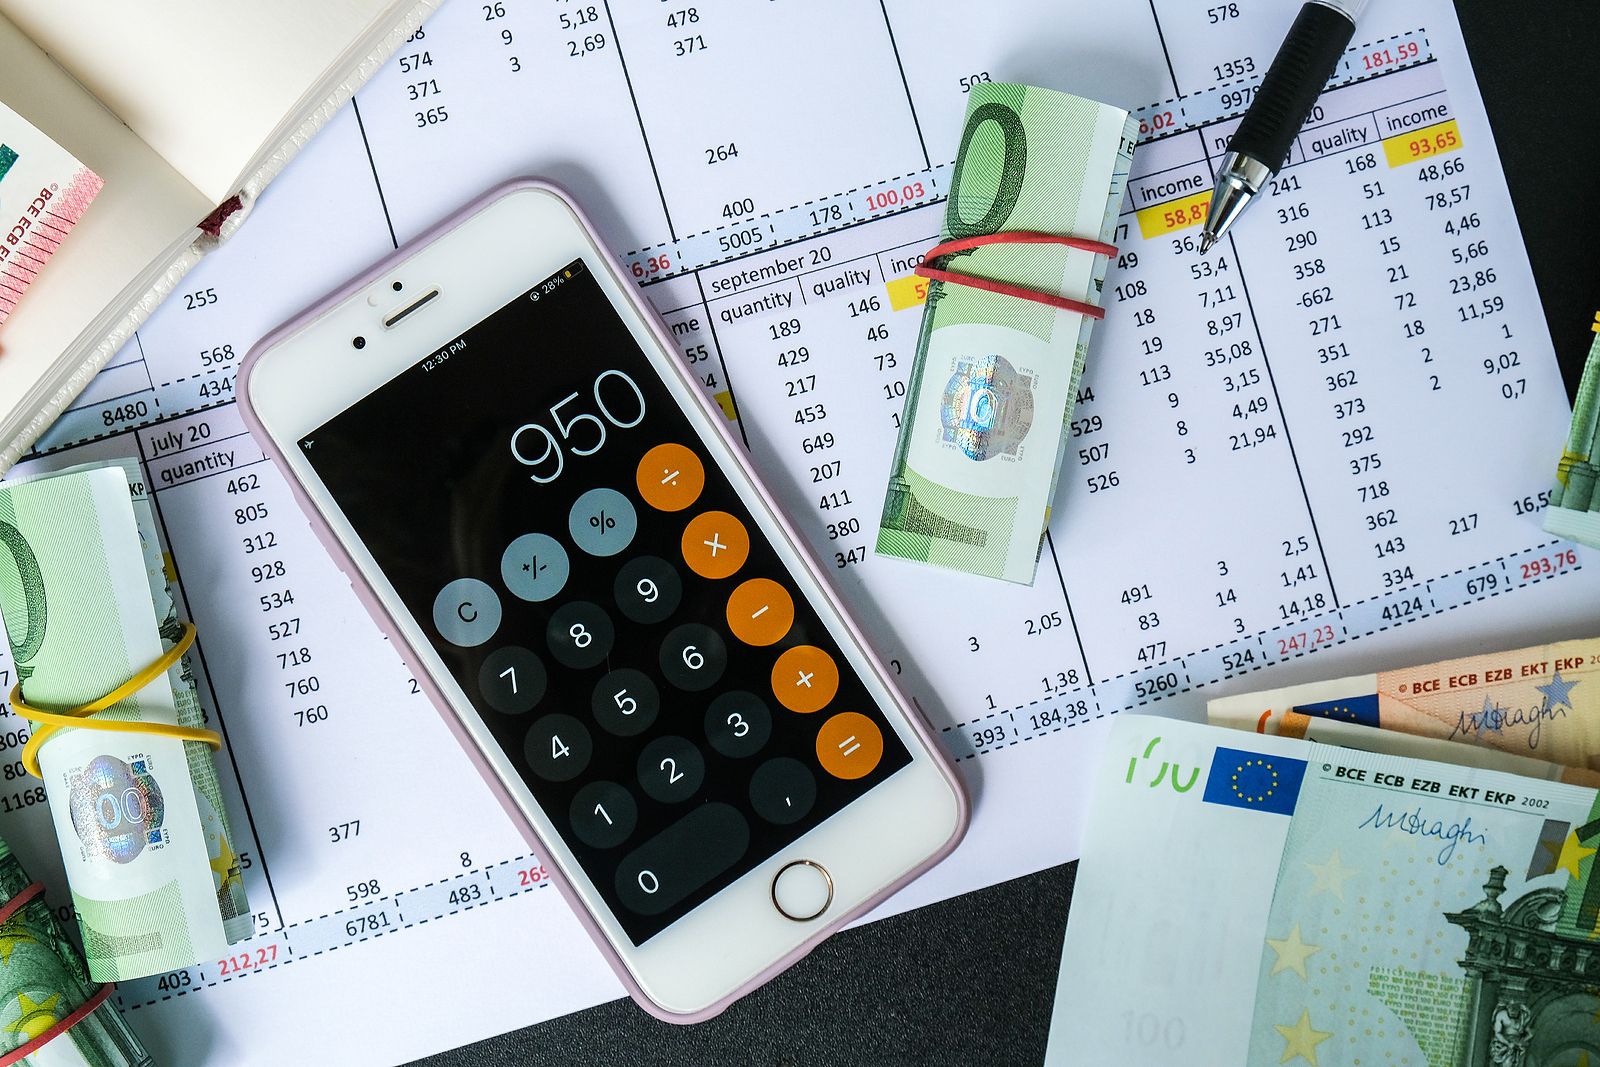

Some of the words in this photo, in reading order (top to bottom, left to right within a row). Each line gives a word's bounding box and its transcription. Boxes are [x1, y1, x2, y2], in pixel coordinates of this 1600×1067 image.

[483, 2, 505, 21] 26
[560, 6, 598, 30] 5,18
[667, 8, 699, 28] 478
[1208, 3, 1239, 24] 578
[567, 33, 605, 57] 2,69
[674, 35, 707, 56] 371
[1363, 41, 1418, 70] 181,59
[399, 51, 433, 73] 574
[1214, 57, 1257, 82] 1353
[407, 79, 441, 100] 371
[415, 106, 448, 128] 365
[1386, 105, 1448, 131] income
[1312, 127, 1367, 155] quality
[1410, 131, 1456, 156] 93,65
[705, 143, 738, 165] 264
[1346, 153, 1376, 174] 168
[1419, 157, 1464, 182] 48,66
[1140, 175, 1203, 202] income
[1269, 175, 1301, 196] 241
[1363, 181, 1385, 199] 51
[27, 188, 53, 218] BCE
[865, 181, 924, 213] 100,03
[1425, 185, 1470, 211] 78,57
[723, 198, 754, 221] 400
[810, 205, 842, 227] 178
[1277, 202, 1309, 224] 316
[1362, 209, 1392, 230] 113
[6, 216, 32, 245] ECB
[1445, 213, 1480, 236] 4,46
[718, 226, 762, 254] 5005
[1285, 231, 1317, 252] 290
[1380, 236, 1400, 255] 15
[1452, 240, 1488, 263] 5,66
[711, 257, 806, 295] september
[810, 246, 831, 265] 20
[1191, 257, 1228, 280] 53,4
[1294, 259, 1325, 280] 358
[1387, 265, 1409, 283] 21
[542, 276, 564, 294] 28%
[813, 269, 870, 297] quality
[1115, 280, 1147, 302] 108
[1449, 268, 1496, 294] 23,86
[184, 288, 217, 310] 255
[848, 296, 880, 317] 146
[1198, 285, 1236, 308] 7,11
[1296, 287, 1333, 307] -662
[1394, 292, 1417, 310] 72
[721, 292, 791, 324] quantity
[1134, 309, 1155, 327] 18
[1458, 296, 1504, 322] 11,59
[769, 319, 801, 340] 189
[868, 324, 889, 342] 46
[1207, 312, 1241, 336] 8,97
[1309, 315, 1341, 336] 271
[1404, 320, 1425, 338] 18
[200, 344, 235, 368] 568
[422, 351, 449, 372] 12:30
[449, 339, 467, 354] PM
[778, 347, 809, 367] 429
[1142, 337, 1162, 355] 19
[1205, 341, 1252, 367] 35,08
[1318, 343, 1350, 363] 351
[874, 353, 896, 371] 73
[1484, 351, 1520, 374] 9,02
[785, 375, 815, 397] 217
[1140, 365, 1171, 386] 113
[1223, 369, 1260, 392] 3,15
[1326, 370, 1358, 391] 362
[1502, 379, 1526, 399] 0,7
[102, 401, 147, 426] 8480
[795, 404, 826, 424] 453
[1233, 397, 1268, 420] 4,49
[1334, 398, 1365, 419] 373
[511, 370, 647, 485] 950
[1070, 415, 1102, 437] 529
[1342, 426, 1374, 447] 292
[151, 431, 183, 457] july
[188, 423, 210, 442] 20
[803, 432, 834, 454] 649
[1229, 425, 1276, 451] 21,94
[1079, 443, 1108, 465] 507
[1350, 453, 1381, 475] 375
[160, 449, 235, 485] quantity
[810, 460, 840, 483] 207
[227, 474, 260, 495] 462
[1087, 471, 1119, 493] 526
[1357, 481, 1389, 502] 718
[820, 490, 852, 510] 411
[235, 503, 268, 524] 805
[1366, 509, 1398, 530] 362
[1449, 513, 1478, 535] 217
[826, 518, 859, 541] 380
[243, 532, 277, 554] 312
[1282, 536, 1308, 556] 2,5
[1375, 537, 1405, 558] 143
[458, 602, 477, 622] C
[590, 510, 615, 535] %
[834, 546, 865, 569] 347
[1520, 548, 1576, 579] 293,76
[252, 561, 286, 583] 928
[1281, 564, 1317, 587] 1,41
[1383, 566, 1414, 587] 334
[1121, 584, 1152, 604] 491
[1467, 574, 1499, 597] 679
[260, 590, 294, 612] 534
[1216, 589, 1237, 607] 14
[1279, 593, 1325, 621] 14,18
[1382, 597, 1423, 622] 4124
[269, 618, 300, 641] 527
[1025, 611, 1062, 635] 2,05
[1139, 612, 1160, 630] 83
[499, 667, 517, 694] 7
[570, 623, 592, 648] 8
[637, 579, 658, 602] 9
[1278, 624, 1334, 656] 247,23
[276, 647, 311, 669] 718
[1138, 641, 1167, 664] 477
[1222, 649, 1254, 671] 524
[1042, 669, 1080, 695] 1,38
[1135, 673, 1178, 699] 5260
[1413, 679, 1440, 694] BCE
[1449, 674, 1477, 688] ECB
[1485, 668, 1512, 683] EZB
[1521, 662, 1548, 677] EKT
[1555, 657, 1584, 672] EKP
[285, 676, 319, 698] 760
[552, 735, 569, 759] 4
[614, 689, 636, 715] 5
[683, 646, 704, 669] 6
[294, 705, 328, 727] 760
[1030, 700, 1089, 732] 184,38
[973, 726, 1005, 749] 393
[594, 803, 612, 825] 1
[660, 758, 684, 784] 2
[727, 713, 749, 737] 3
[1335, 766, 1367, 781] BCE
[1374, 773, 1405, 787] ECB
[1411, 779, 1441, 793] EZB
[1449, 785, 1480, 799] EKT
[1485, 790, 1516, 805] EKP
[1521, 797, 1549, 809] 2002
[2, 787, 47, 813] 1168
[329, 820, 360, 843] 377
[460, 852, 472, 867] 8
[347, 879, 380, 903] 598
[638, 870, 659, 893] 0
[449, 884, 481, 908] 483
[346, 911, 390, 937] 6781
[218, 944, 277, 978] 212,27
[157, 969, 191, 990] 403
